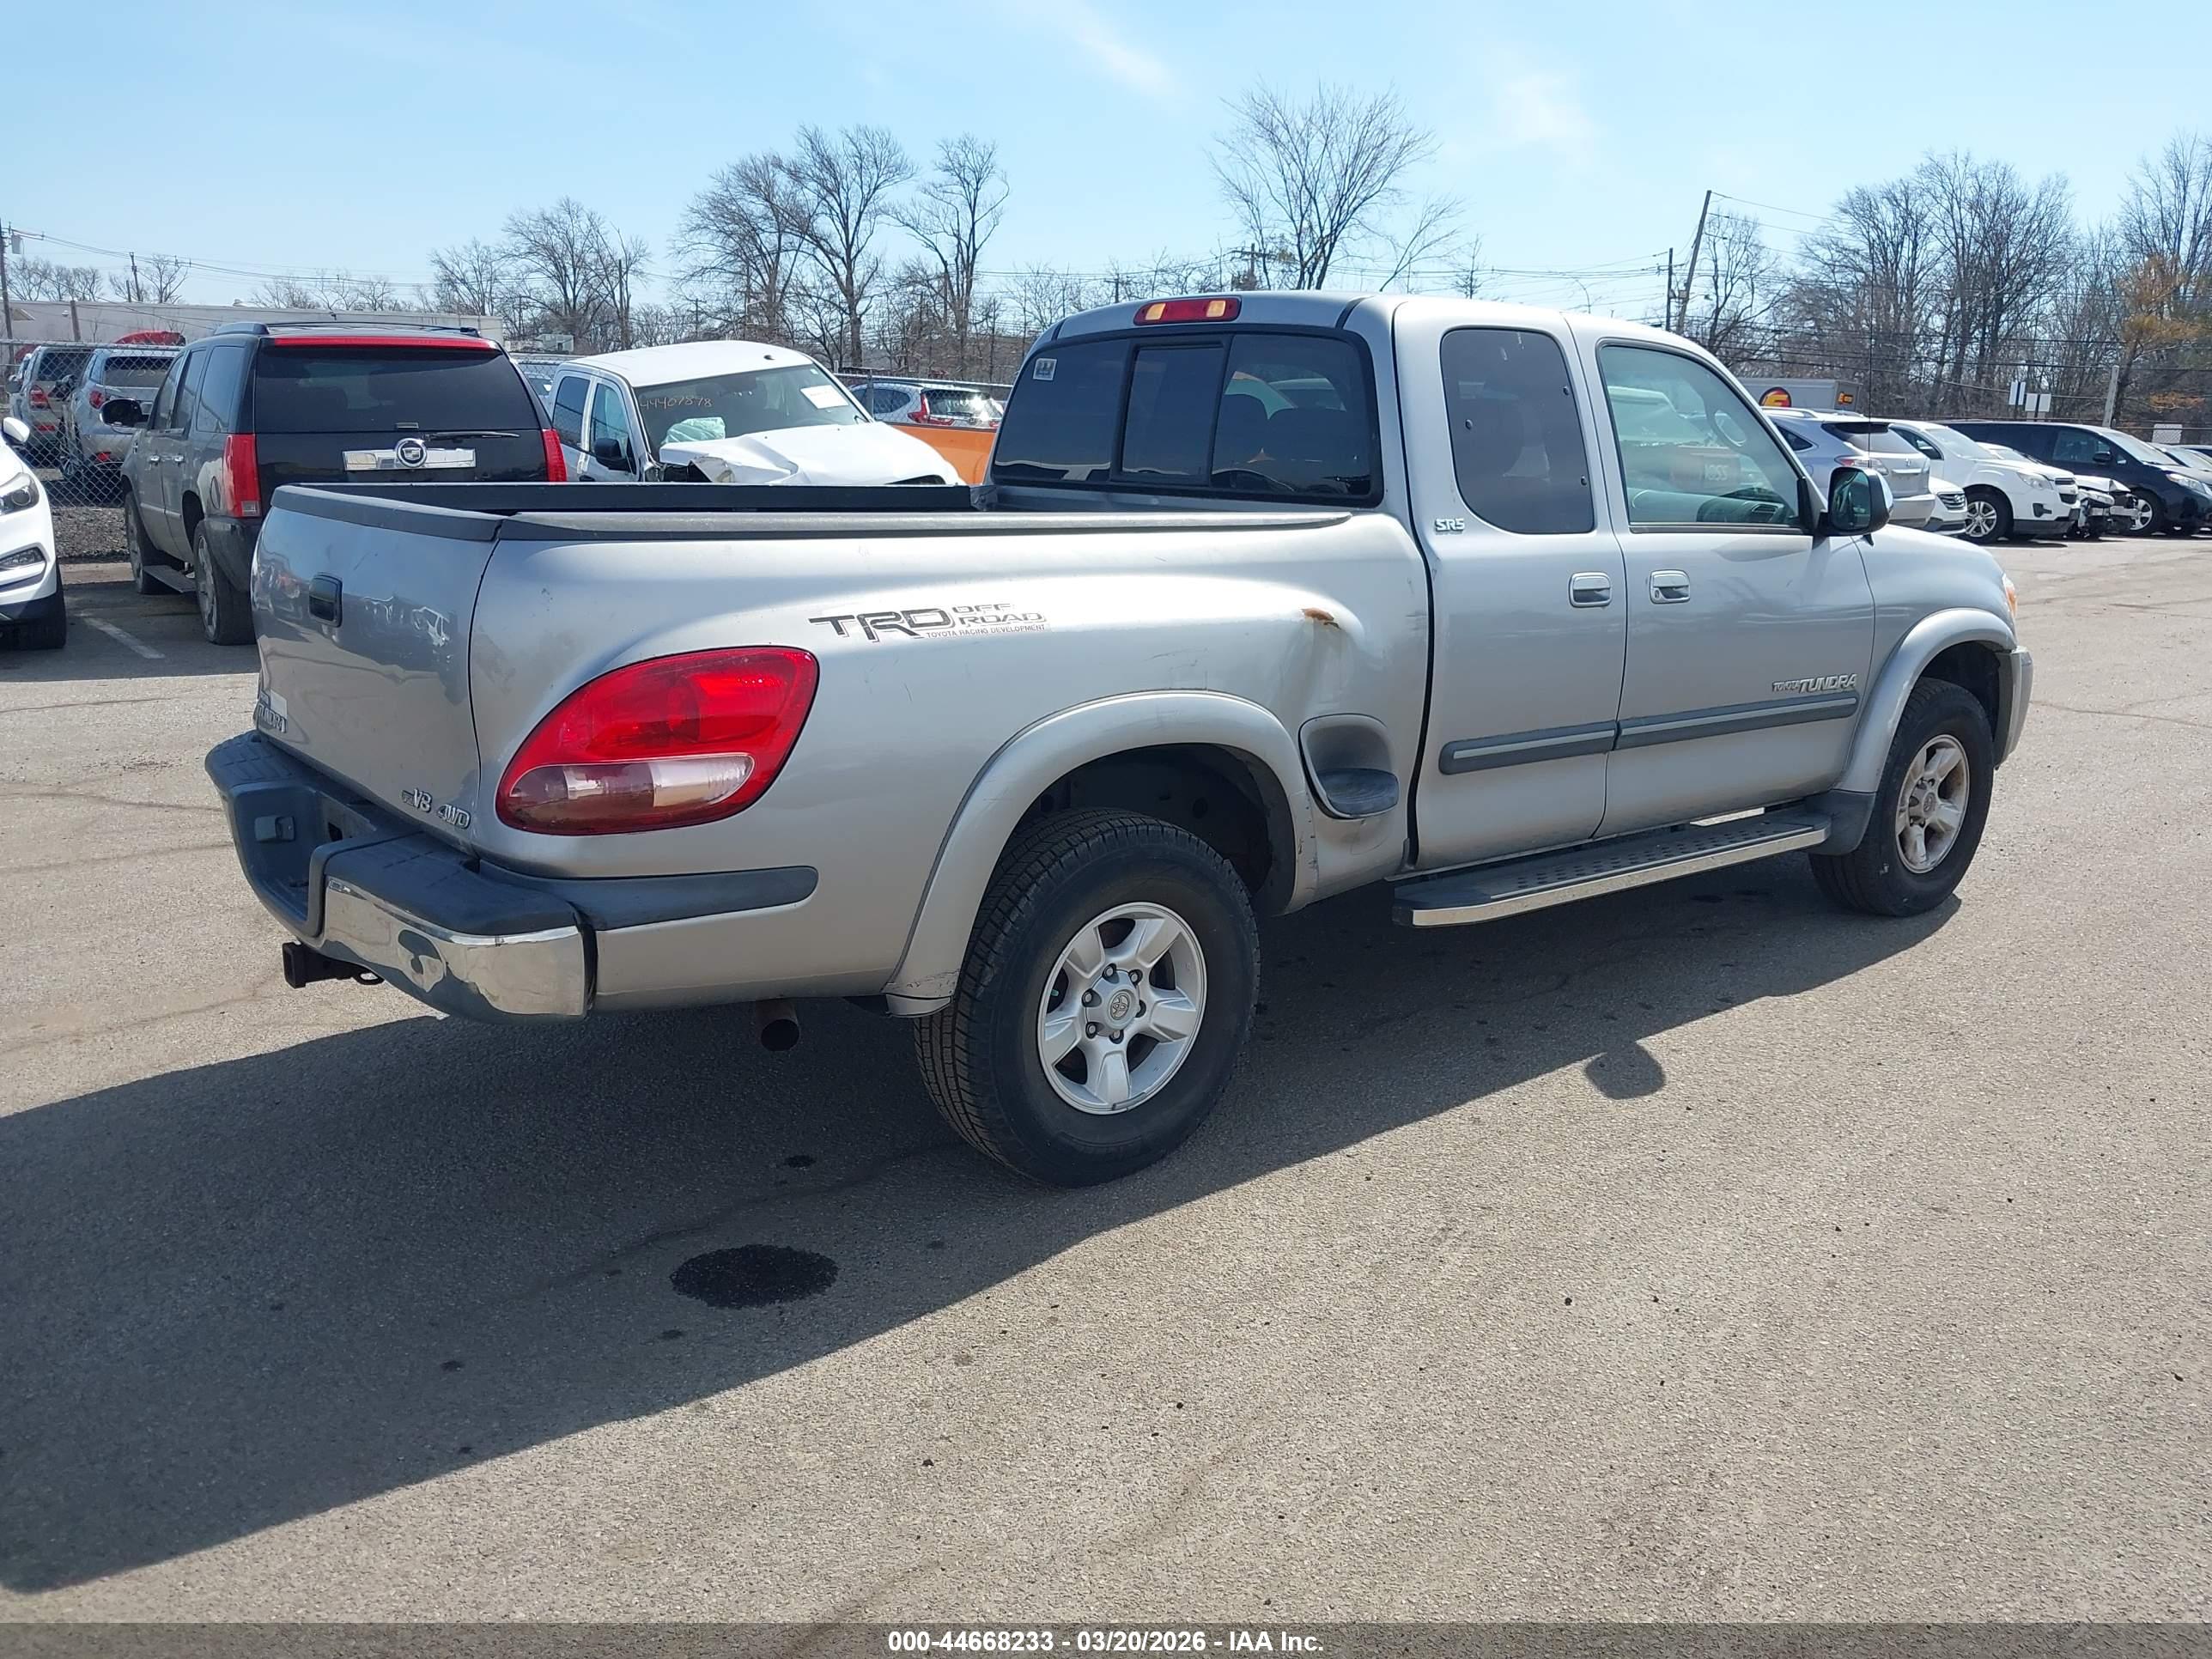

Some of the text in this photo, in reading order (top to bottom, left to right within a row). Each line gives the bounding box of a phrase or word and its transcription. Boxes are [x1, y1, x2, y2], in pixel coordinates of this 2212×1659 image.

[1436, 518, 1465, 532] SR5
[951, 603, 1011, 614] OFF
[808, 608, 954, 642] TRD
[958, 612, 1047, 626] ROAD
[926, 623, 1046, 639] TOYOTA RACING DEVELOPMENT
[1799, 673, 1856, 694] TUNDRA
[413, 787, 432, 812] V8
[437, 804, 471, 829] 4WD
